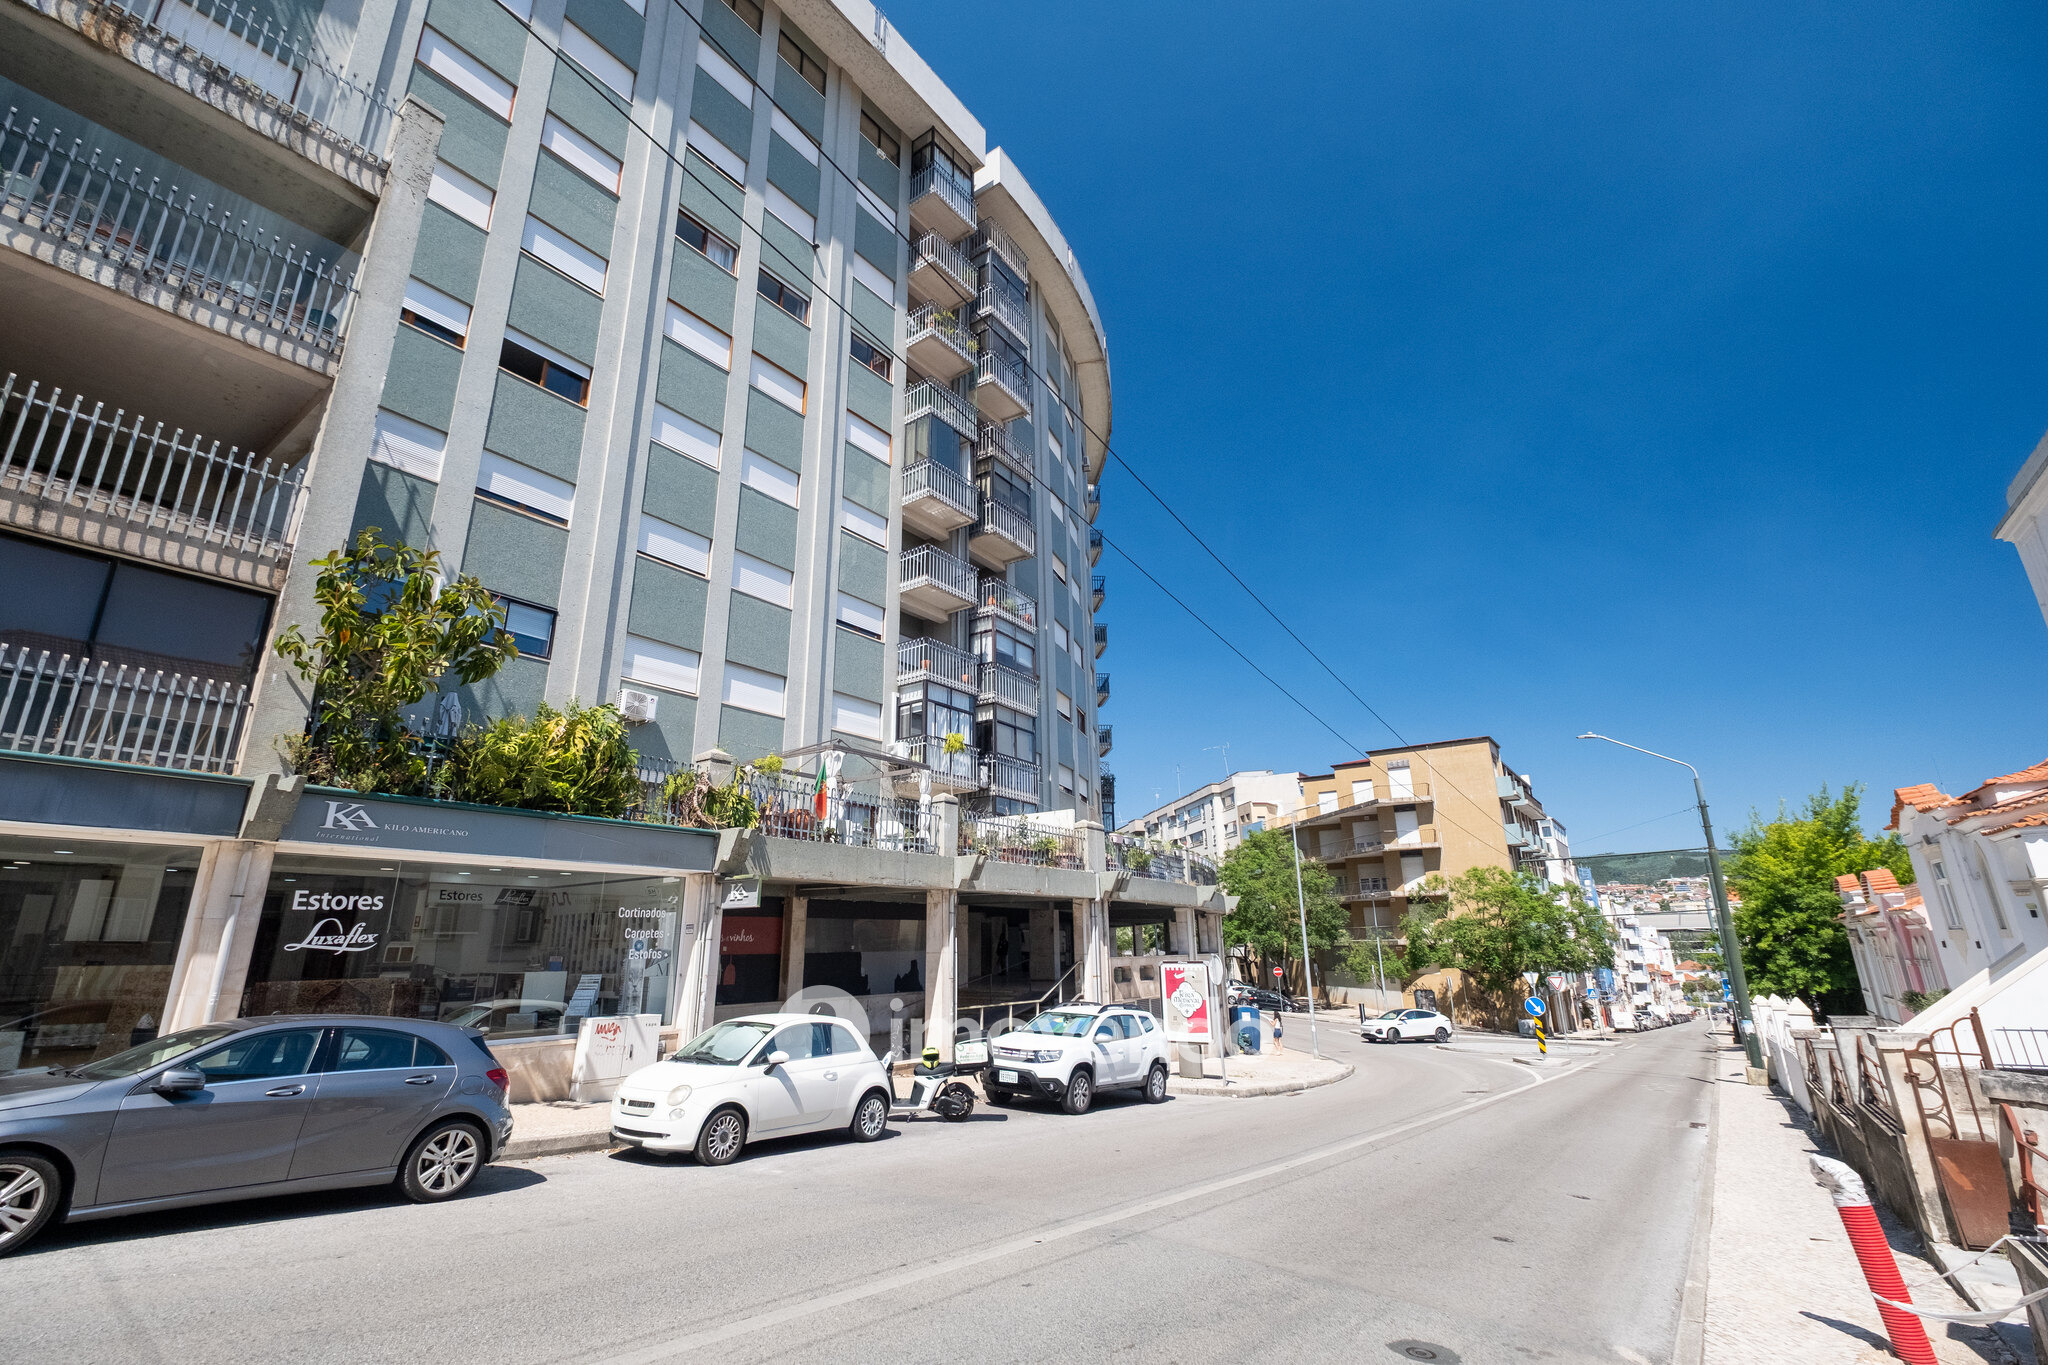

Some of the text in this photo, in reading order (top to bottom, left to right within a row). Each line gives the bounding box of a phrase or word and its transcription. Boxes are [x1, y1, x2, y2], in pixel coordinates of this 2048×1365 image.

[318, 800, 381, 832] KA
[314, 831, 381, 842] International
[384, 823, 469, 837] KILO AMERICANO
[292, 889, 384, 911] Estores
[439, 889, 483, 901] Estores
[618, 907, 667, 918] Cortinados
[284, 917, 379, 956] Luxaflex
[624, 927, 664, 941] Carpetes
[729, 928, 754, 942] vinhos
[628, 948, 662, 960] Estofos
